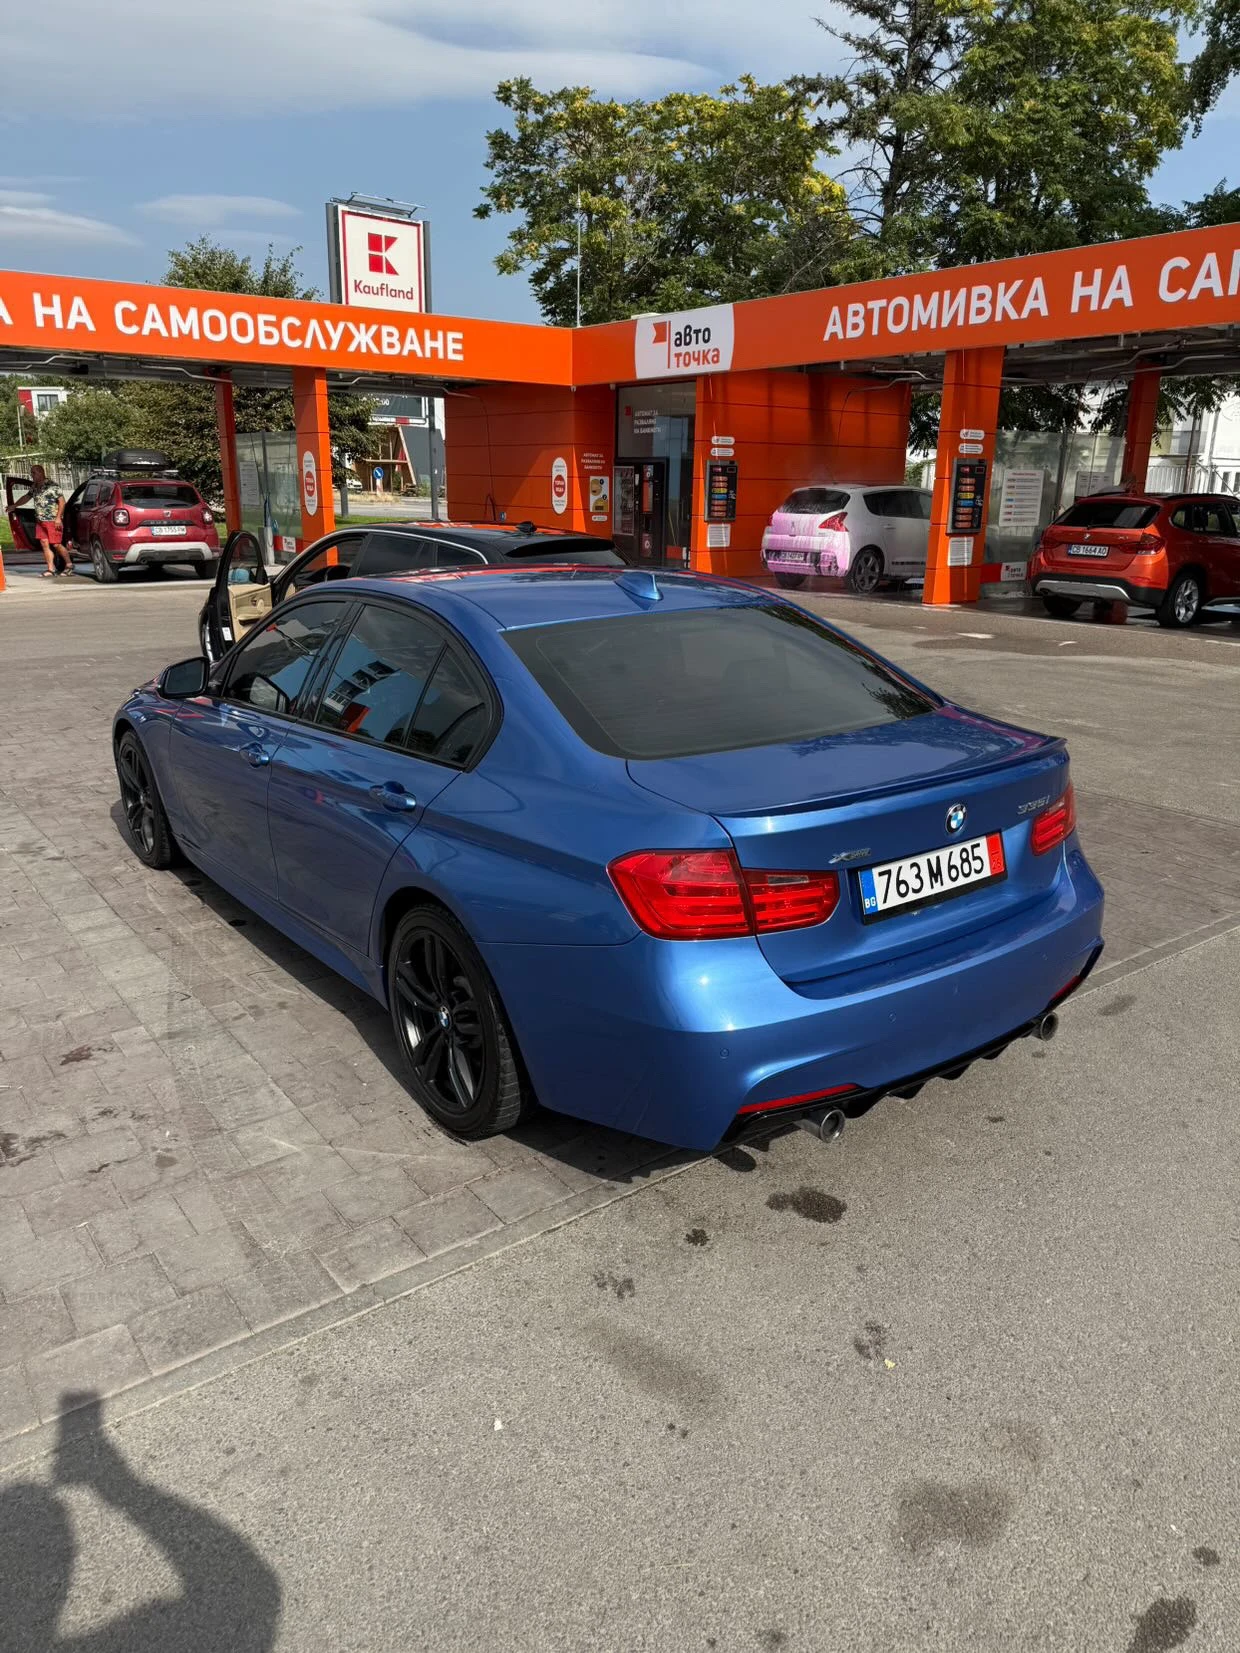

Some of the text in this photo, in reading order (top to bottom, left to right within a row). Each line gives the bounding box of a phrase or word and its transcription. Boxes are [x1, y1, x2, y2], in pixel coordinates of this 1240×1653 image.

[354, 279, 414, 300] Kaufland
[823, 276, 1049, 341] АВТОМИВКА
[1070, 264, 1134, 313] НА
[32, 292, 96, 332] НА
[114, 300, 464, 361] САМООБСЛУЖВАНЕ
[674, 324, 711, 347] авто
[674, 347, 720, 368] точка
[878, 842, 985, 905] 763 M 685
[864, 897, 876, 909] BG
